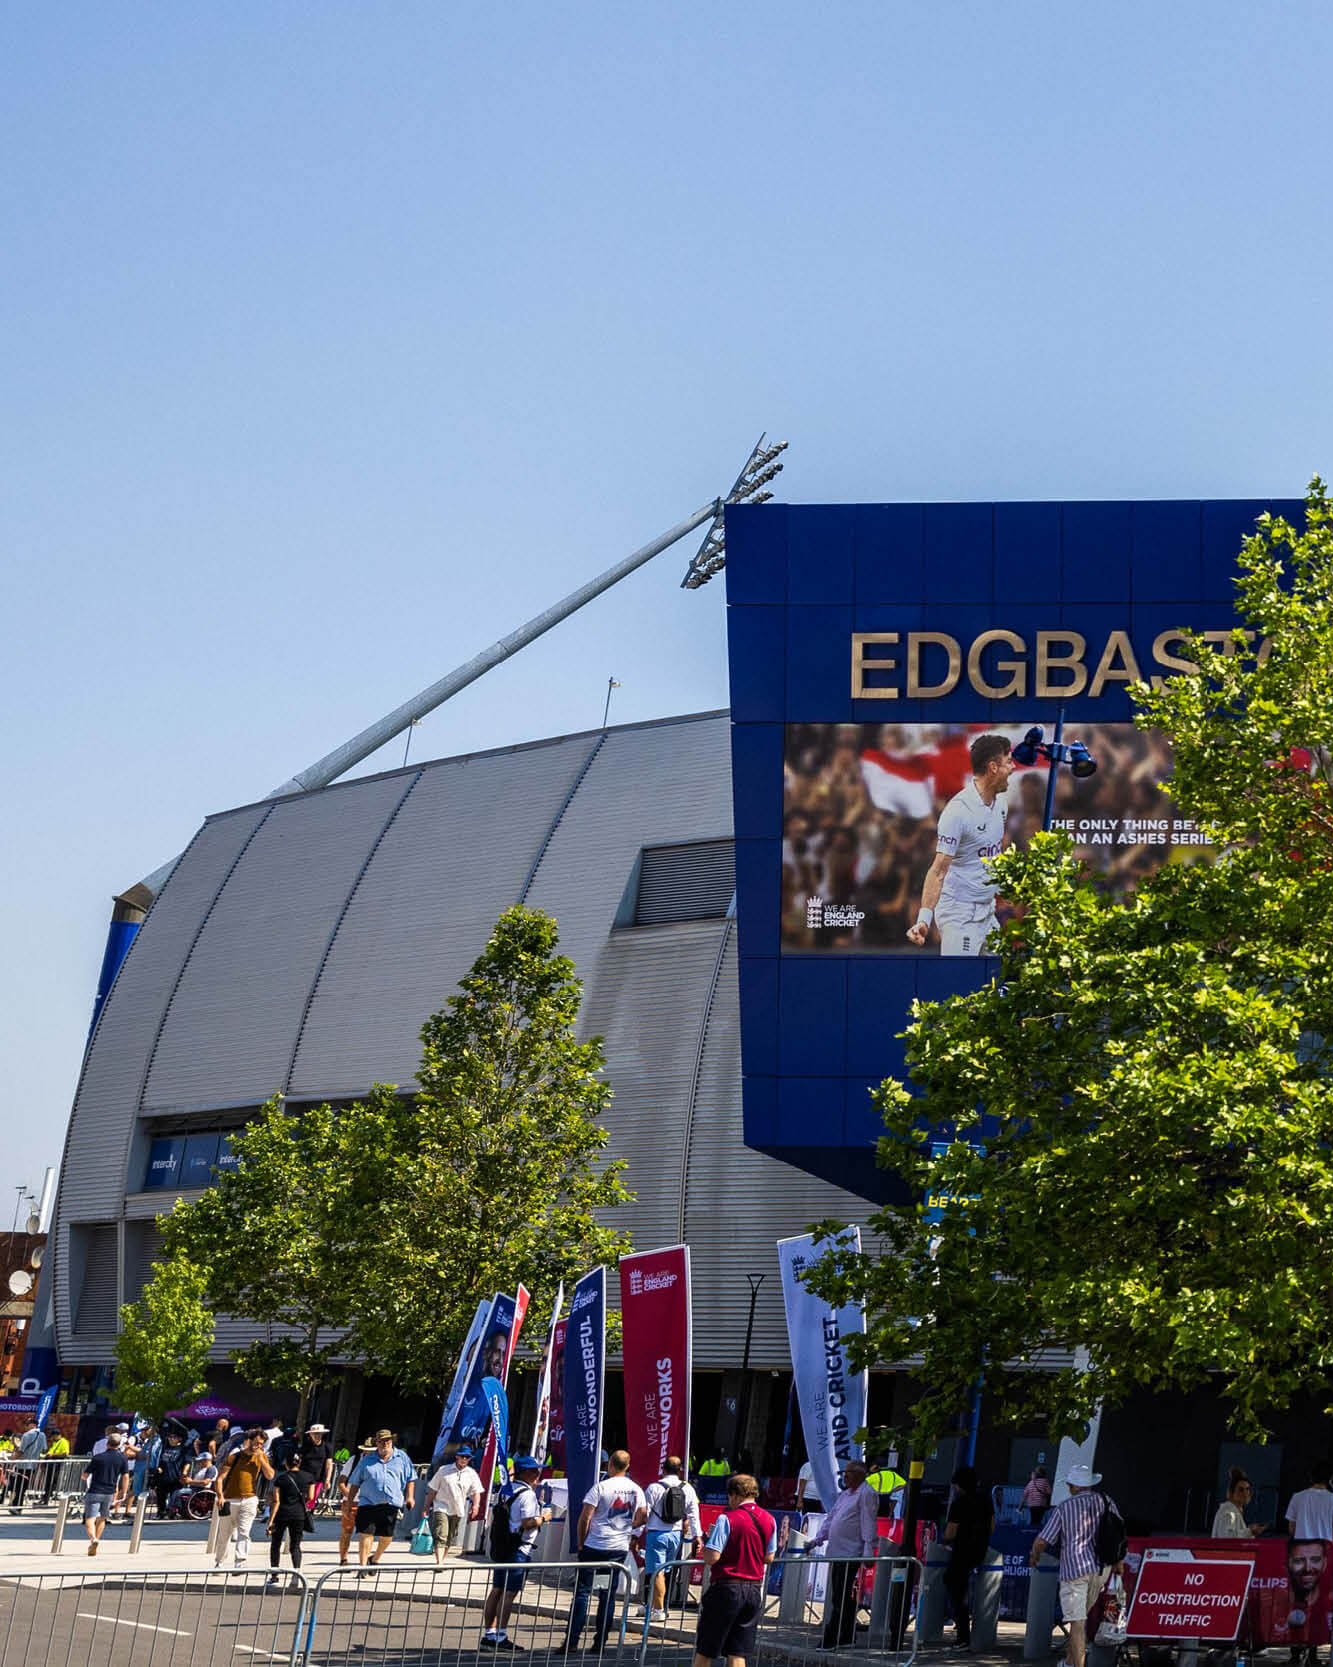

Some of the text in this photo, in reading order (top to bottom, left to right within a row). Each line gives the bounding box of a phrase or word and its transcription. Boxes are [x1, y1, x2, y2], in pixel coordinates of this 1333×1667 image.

[850, 629, 1277, 699] EDGBAST
[1049, 819, 1075, 831] THE
[1079, 819, 1119, 831] ONLY
[1122, 819, 1169, 831] THING
[1091, 833, 1113, 845] AN
[1117, 833, 1166, 845] ASHES
[1170, 832, 1215, 845] SERIE
[824, 911, 865, 920] ENGLAND
[824, 919, 860, 927] CRICKET
[643, 1280, 673, 1291] CRICKET
[644, 1274, 678, 1286] ENGLAND
[822, 1317, 847, 1408] CRICKET
[580, 1315, 597, 1425] WONDERFUL
[644, 1391, 658, 1446] WE ARE
[656, 1356, 672, 1476] FIREWORKS
[814, 1392, 828, 1451] WE ARE
[1184, 1573, 1205, 1586] NO
[1250, 1577, 1289, 1589] CLIPS
[1138, 1592, 1241, 1607] CONSTRUCTION
[1158, 1613, 1212, 1627] TRAFFIC
